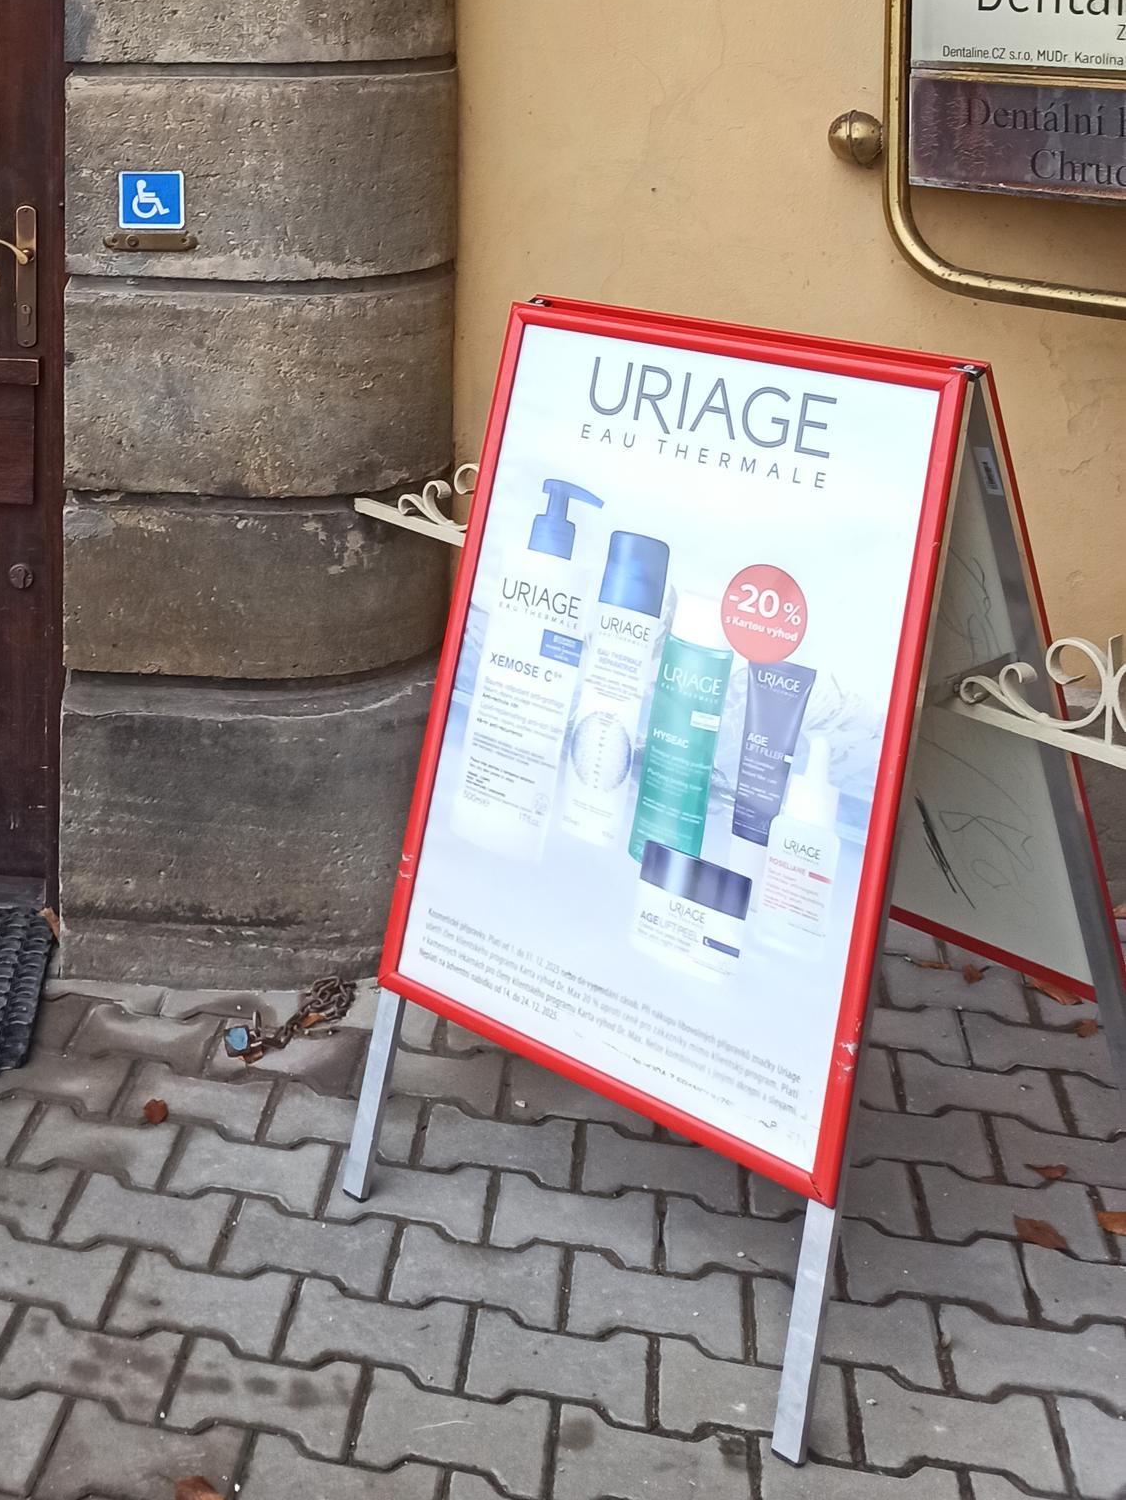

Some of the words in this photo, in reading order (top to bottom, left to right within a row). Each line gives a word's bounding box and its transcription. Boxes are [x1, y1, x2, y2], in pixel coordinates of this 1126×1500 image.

[967, 98, 1105, 137] Dentální
[589, 356, 837, 458] URIAGE
[581, 424, 636, 448] EAU
[658, 439, 827, 489] THERMALE
[502, 577, 581, 619] URIAGE
[600, 615, 651, 642] URIAGE
[732, 616, 766, 633] Kartou
[766, 626, 799, 642] výhod
[490, 652, 540, 679] XEMOSE
[663, 663, 723, 696] URIAGE
[758, 669, 801, 693] URIAGE
[653, 727, 690, 749] HYSEAC
[747, 732, 769, 747] AGE
[784, 838, 822, 860] URIAGE
[640, 910, 659, 925] AGE
[669, 899, 706, 925] URIAGE
